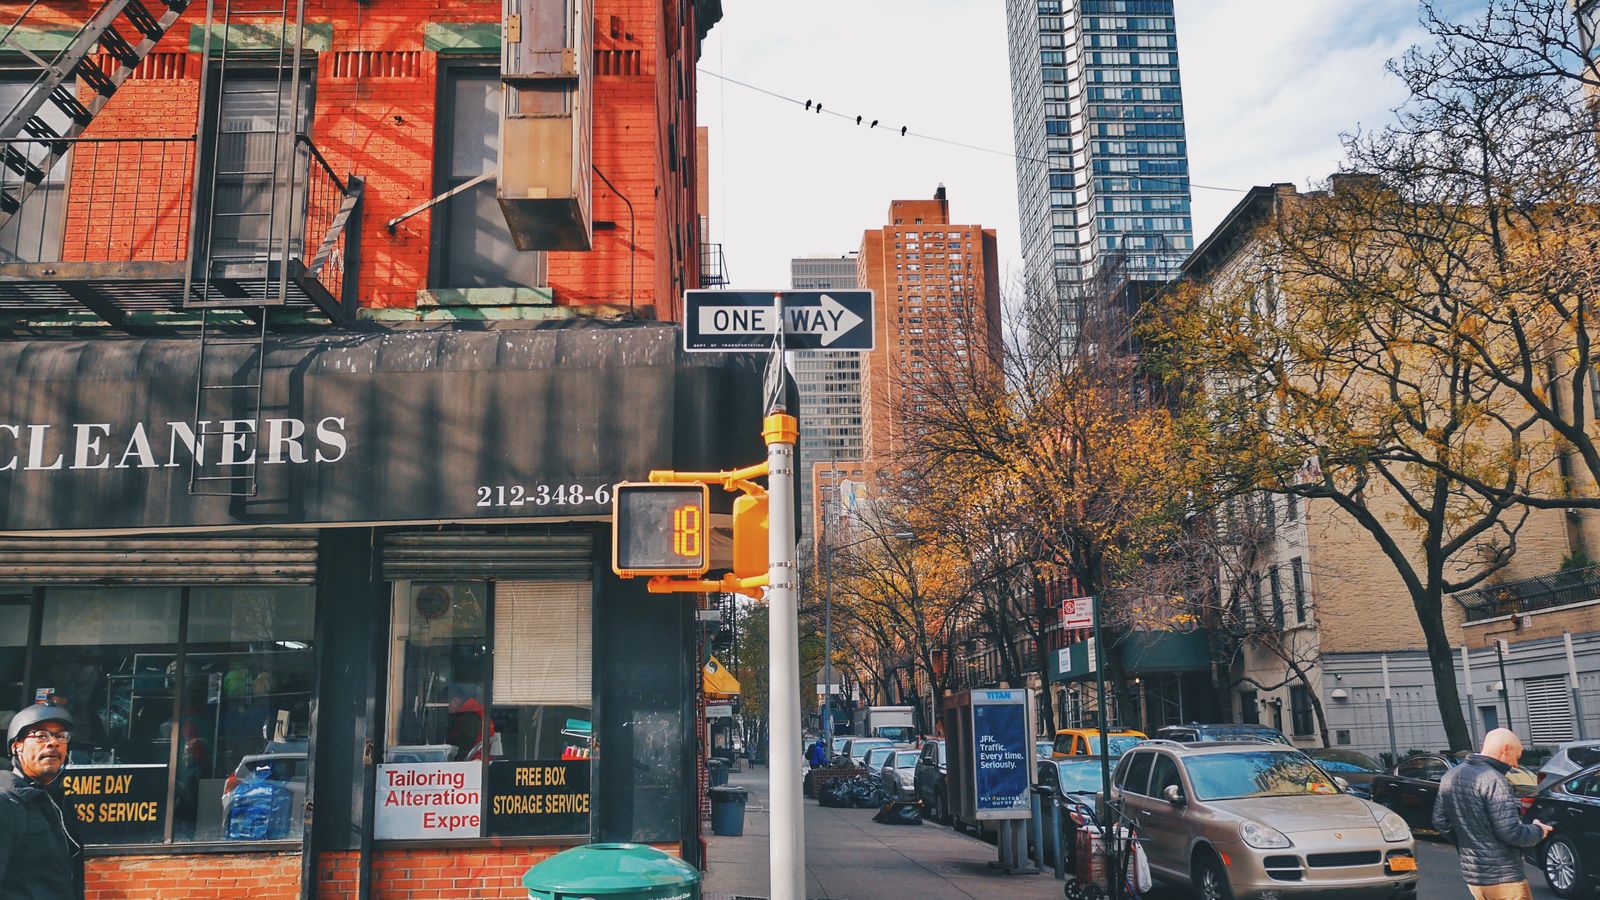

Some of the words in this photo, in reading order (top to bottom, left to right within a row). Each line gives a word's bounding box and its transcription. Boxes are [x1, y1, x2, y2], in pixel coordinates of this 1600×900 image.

[713, 309, 766, 331] ONE
[790, 309, 845, 331] WAY
[476, 483, 613, 507] 212-348-6
[674, 505, 700, 556] 18
[985, 691, 1012, 699] TITAN
[980, 735, 996, 743] JFK.
[980, 744, 1007, 752] Traffic.
[980, 752, 1003, 761] Every
[1004, 752, 1024, 760] time.
[980, 761, 1017, 769] Seriously.
[63, 775, 102, 796] SAME
[104, 774, 133, 794] DAY
[385, 770, 465, 789] Tailoring
[515, 767, 542, 786] FREE
[544, 766, 566, 785] BOX
[384, 789, 479, 807] Alteration
[493, 795, 543, 815] STORAGE
[545, 793, 589, 814] SERVICE
[98, 801, 158, 822] SERVICE
[423, 812, 480, 831] Expre
